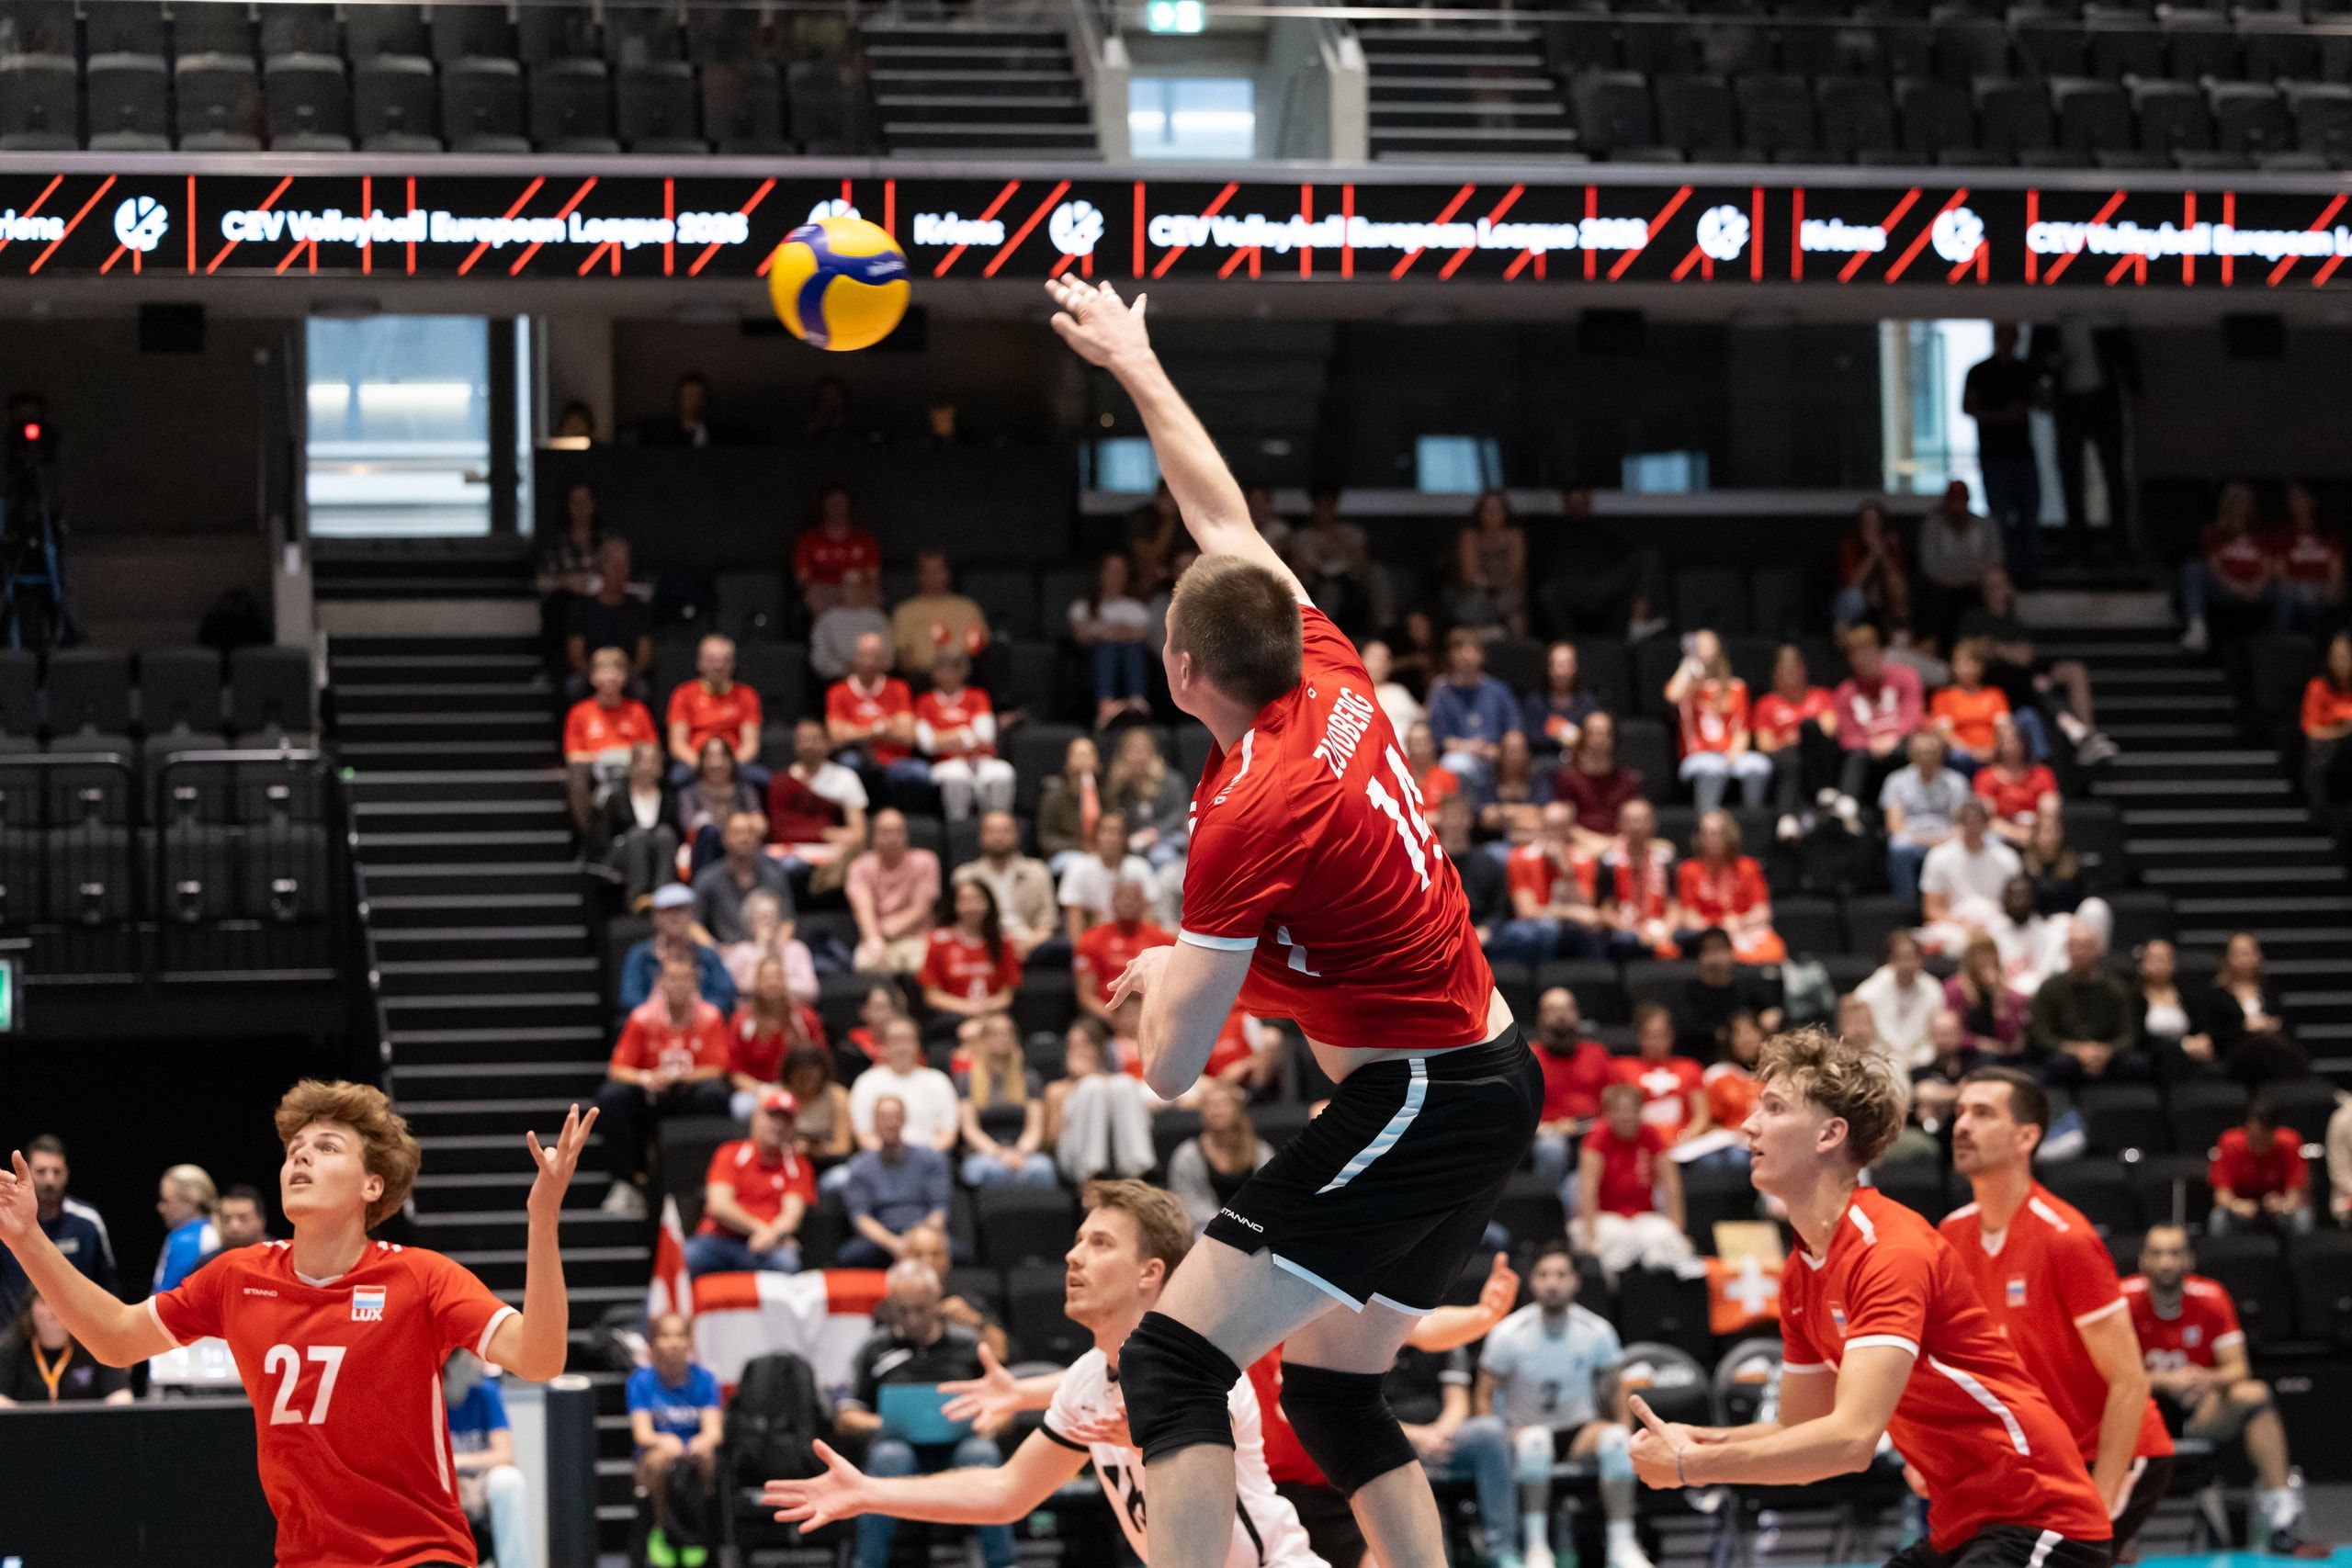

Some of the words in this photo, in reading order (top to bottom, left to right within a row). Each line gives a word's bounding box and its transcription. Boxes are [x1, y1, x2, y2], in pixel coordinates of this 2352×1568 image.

[221, 209, 286, 242] CEV
[287, 209, 428, 248] Volleyball
[430, 210, 567, 248] European
[569, 211, 675, 250] League
[1148, 214, 1211, 246] CEV
[1210, 213, 1346, 254] Volleyball
[1346, 216, 1476, 254] European
[1476, 217, 1578, 255] League
[2026, 221, 2086, 254] CEV
[2086, 220, 2212, 261] Volleyball
[2212, 223, 2334, 262] European
[2335, 225, 2352, 256] L
[1220, 1207, 1264, 1234] STANNO
[351, 1308, 383, 1322] LUX
[264, 1343, 347, 1426] 27
